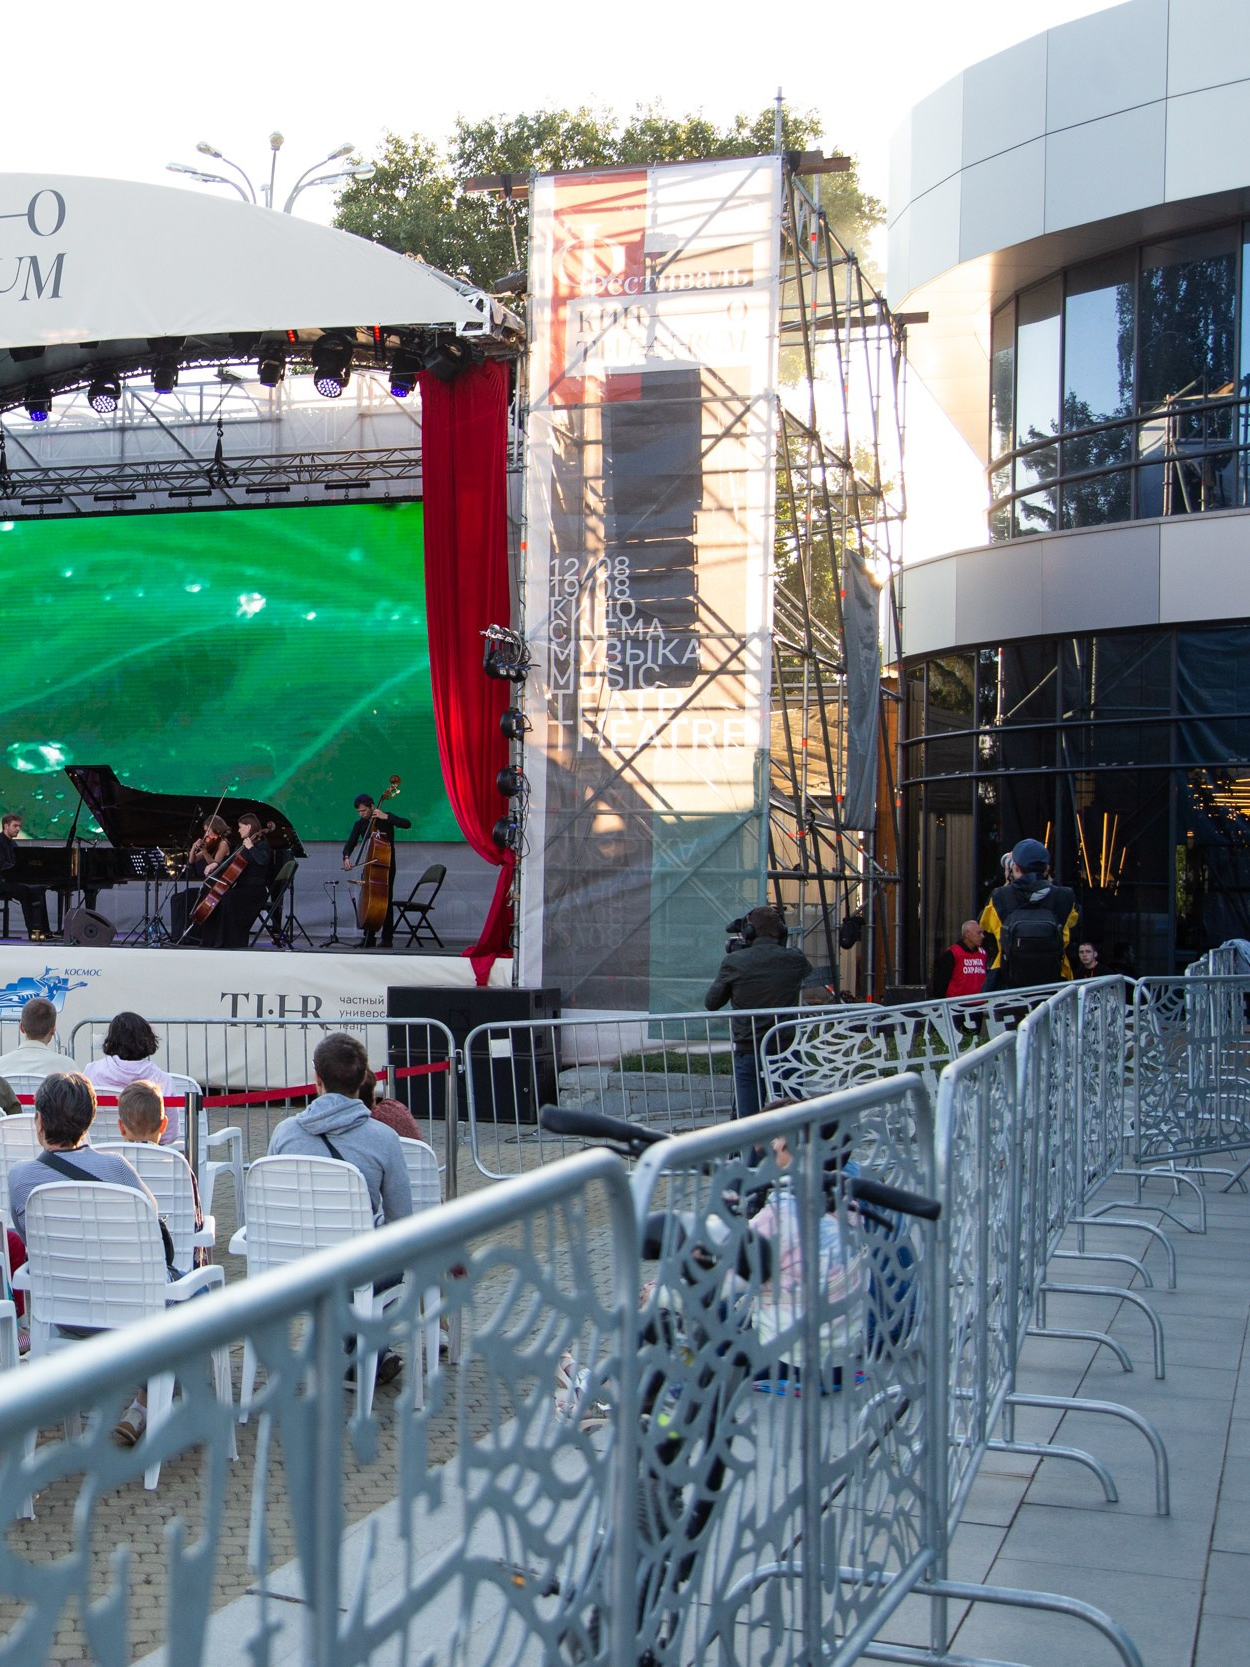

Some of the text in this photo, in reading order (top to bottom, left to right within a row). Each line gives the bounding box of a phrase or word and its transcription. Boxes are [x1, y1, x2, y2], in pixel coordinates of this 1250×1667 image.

[549, 556, 630, 582] 12/08
[549, 577, 630, 602] 19/08
[550, 597, 637, 622] КИНО
[549, 617, 666, 643] CINEMA
[551, 637, 701, 668] МУЗЫКА
[551, 662, 661, 693] MUSIC
[64, 968, 102, 976] КОСМОС
[339, 995, 385, 1006] частный
[339, 1009, 388, 1019] универс
